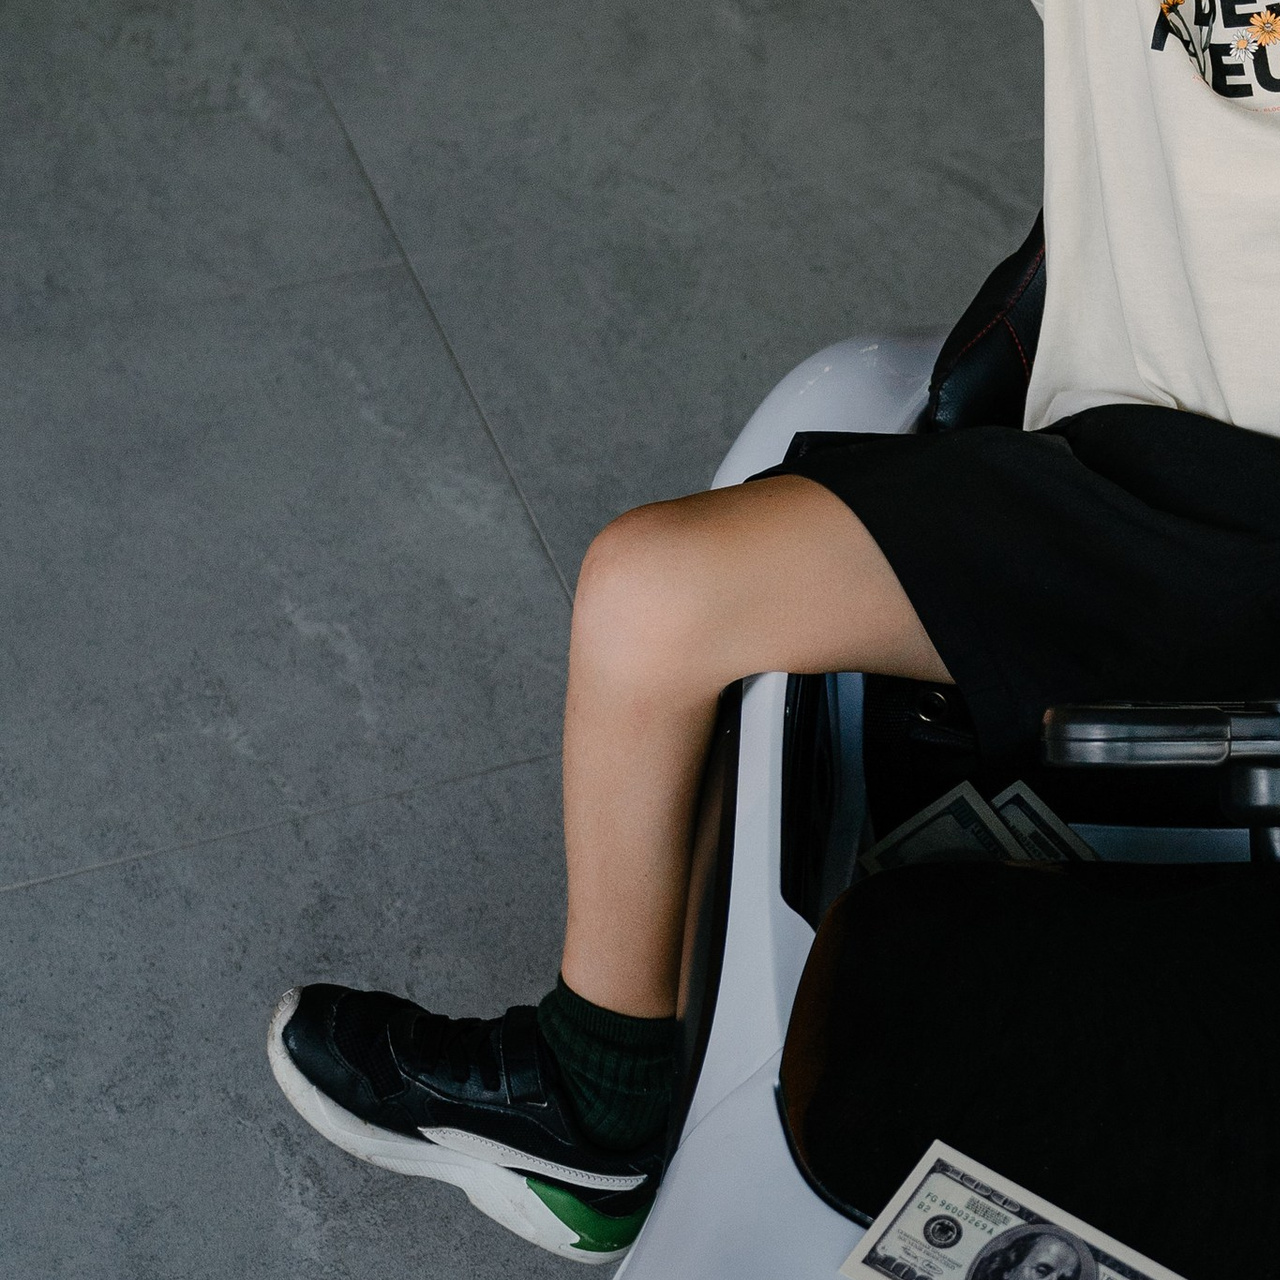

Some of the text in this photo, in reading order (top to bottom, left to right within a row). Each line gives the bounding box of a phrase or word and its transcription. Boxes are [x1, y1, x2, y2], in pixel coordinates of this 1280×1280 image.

[916, 1200, 932, 1214] B2
[924, 1190, 996, 1237] FG 96003269 A
